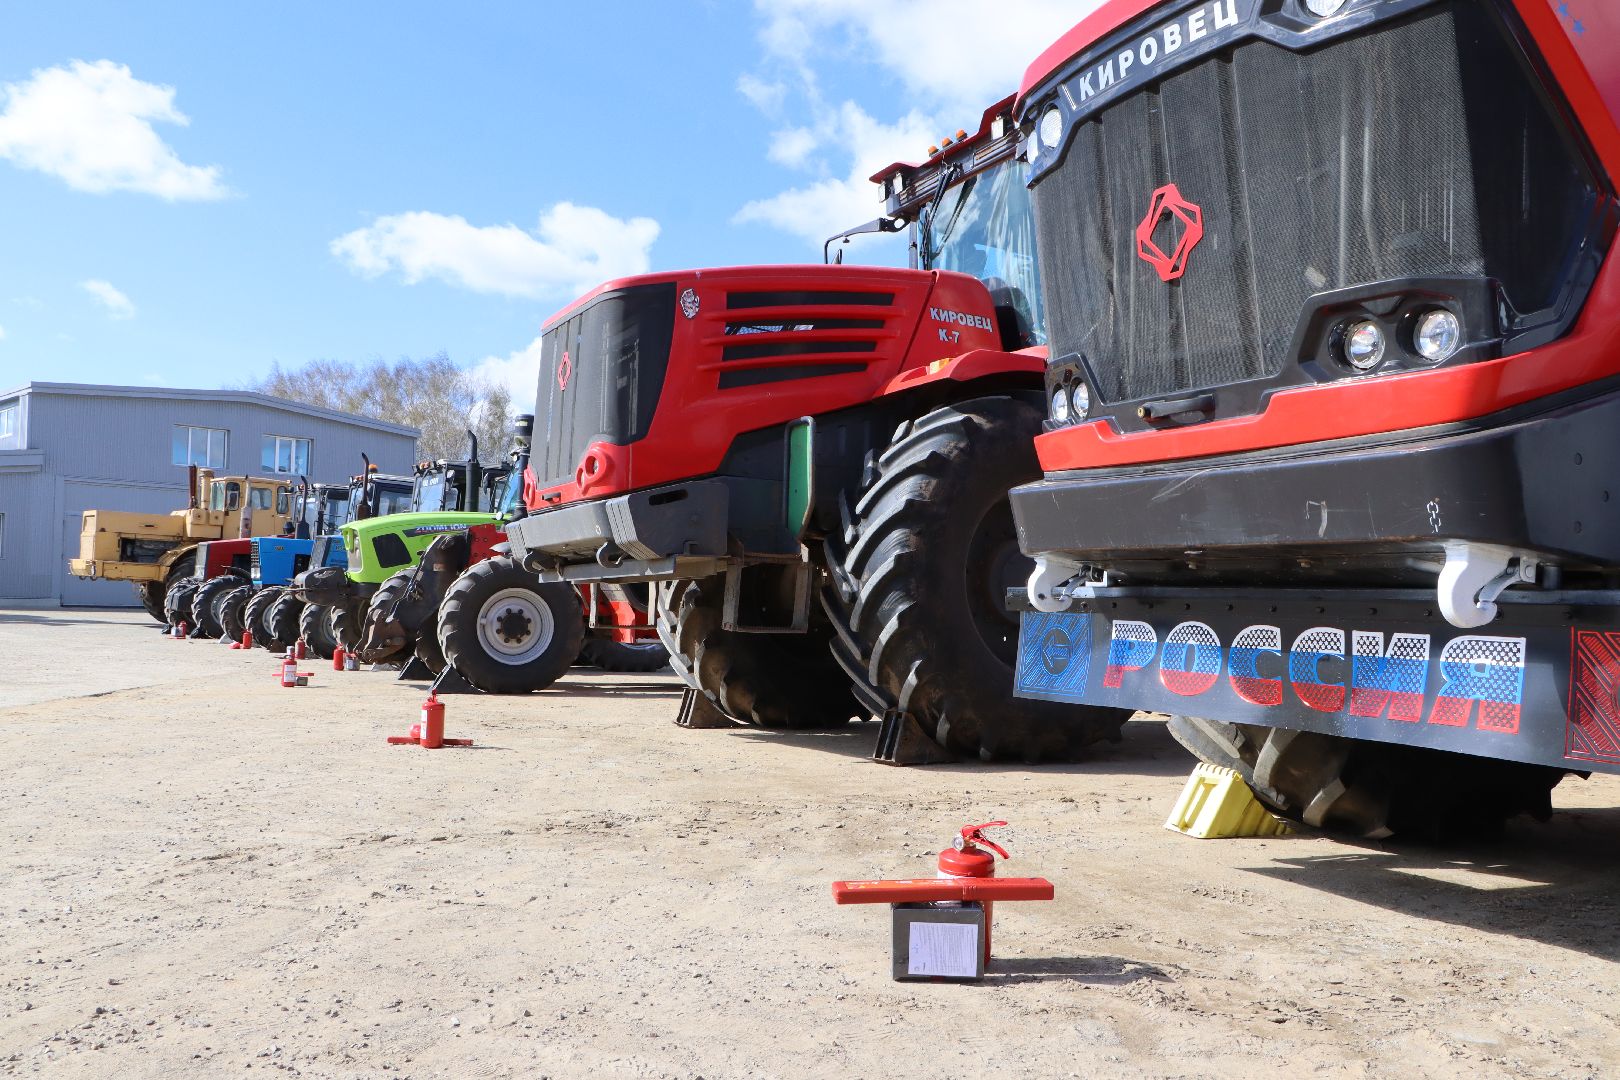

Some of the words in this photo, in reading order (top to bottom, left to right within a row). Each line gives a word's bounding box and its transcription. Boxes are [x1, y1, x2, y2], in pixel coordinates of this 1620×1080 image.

[1079, 0, 1239, 102] КИРОВЕЦ
[929, 307, 993, 333] КИРОВЕЦ
[938, 328, 960, 344] К-7
[1103, 619, 1527, 735] РОССИЯ
